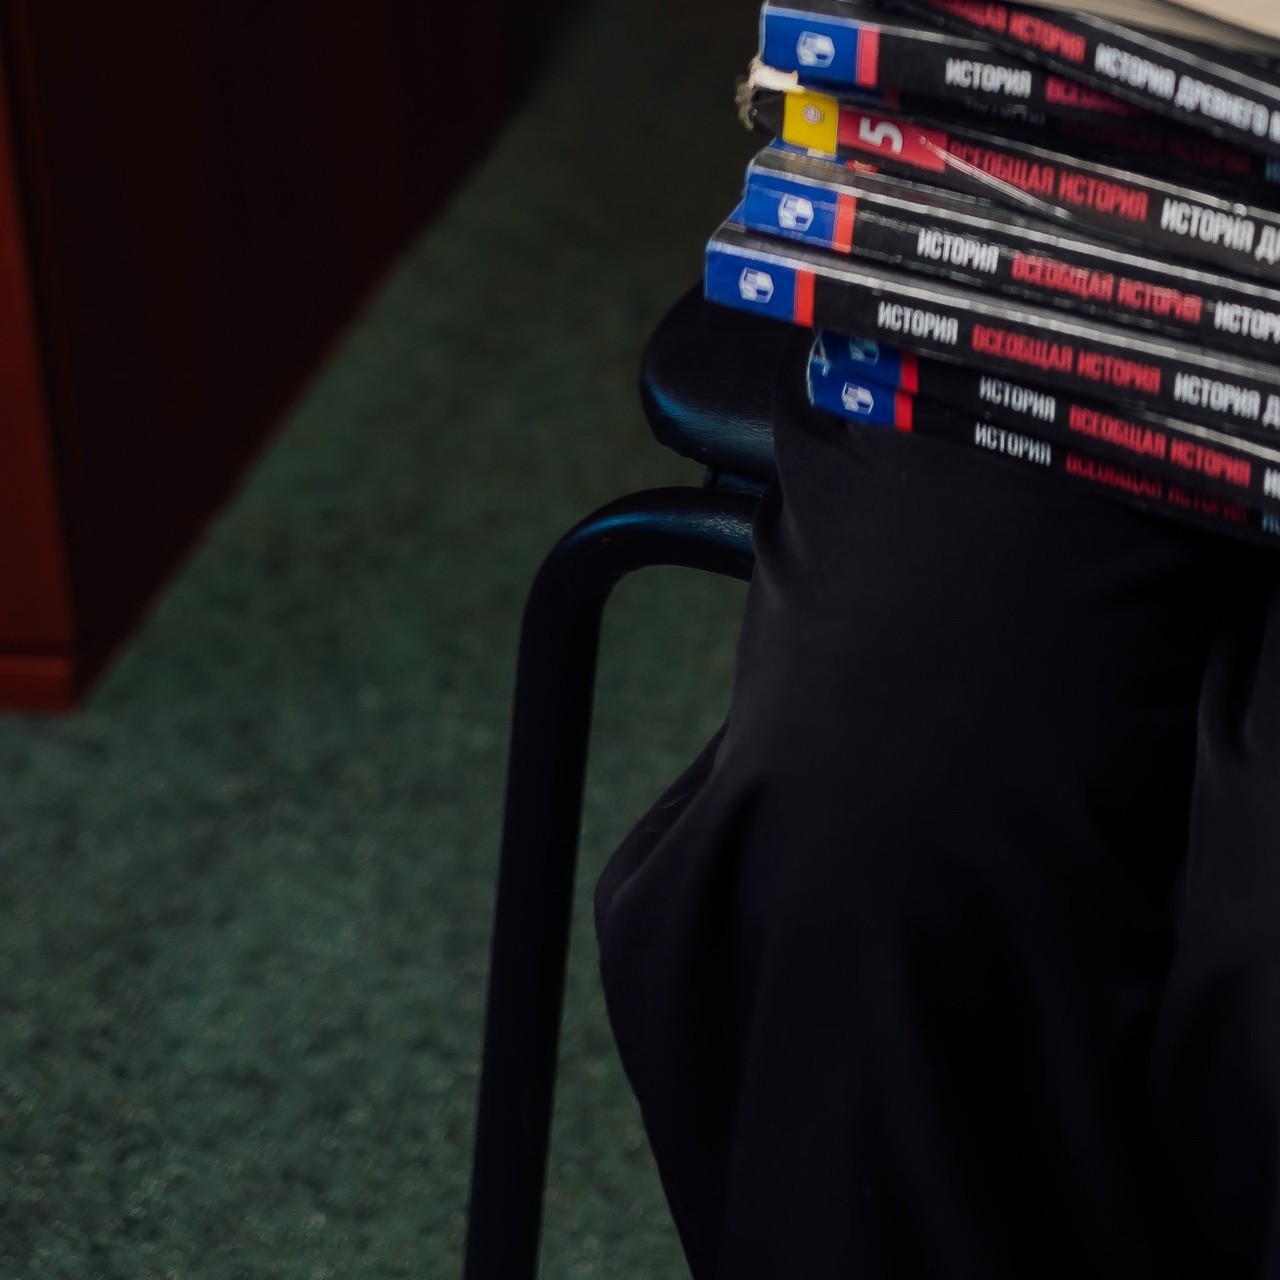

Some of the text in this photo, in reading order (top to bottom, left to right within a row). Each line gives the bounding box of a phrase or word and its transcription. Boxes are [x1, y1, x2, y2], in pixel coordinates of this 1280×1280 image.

[944, 56, 1032, 99] ИСТОРИЯ
[1093, 41, 1177, 101] ИСТОРИЯ
[1174, 73, 1270, 138] ДРЕВНЕГО
[859, 117, 904, 154] 5
[950, 140, 1056, 198] ВСЕОБЩАЯ
[1058, 172, 1149, 222] ИСТОРИЯ
[1160, 197, 1255, 253] ИСТОРИЯ
[917, 228, 1000, 274] ИСТОРИЯ
[1011, 250, 1114, 303] ВСЕОБЩАЯ
[1116, 281, 1203, 324] ИСТОРИЯ
[877, 300, 959, 345] ИСТОРИЯ
[971, 323, 1074, 374] ВСЕОБЩАЯ
[1076, 348, 1162, 395] ИСТОРИЯ
[1173, 371, 1261, 421] ИСТОРИЯ
[974, 421, 1052, 467] ИСТОРИЯ
[979, 374, 1056, 423] ИСТОРИЯ
[1068, 403, 1166, 459] ВСЕОБЩАЯ
[1169, 437, 1252, 489] ИСТОРИЯ
